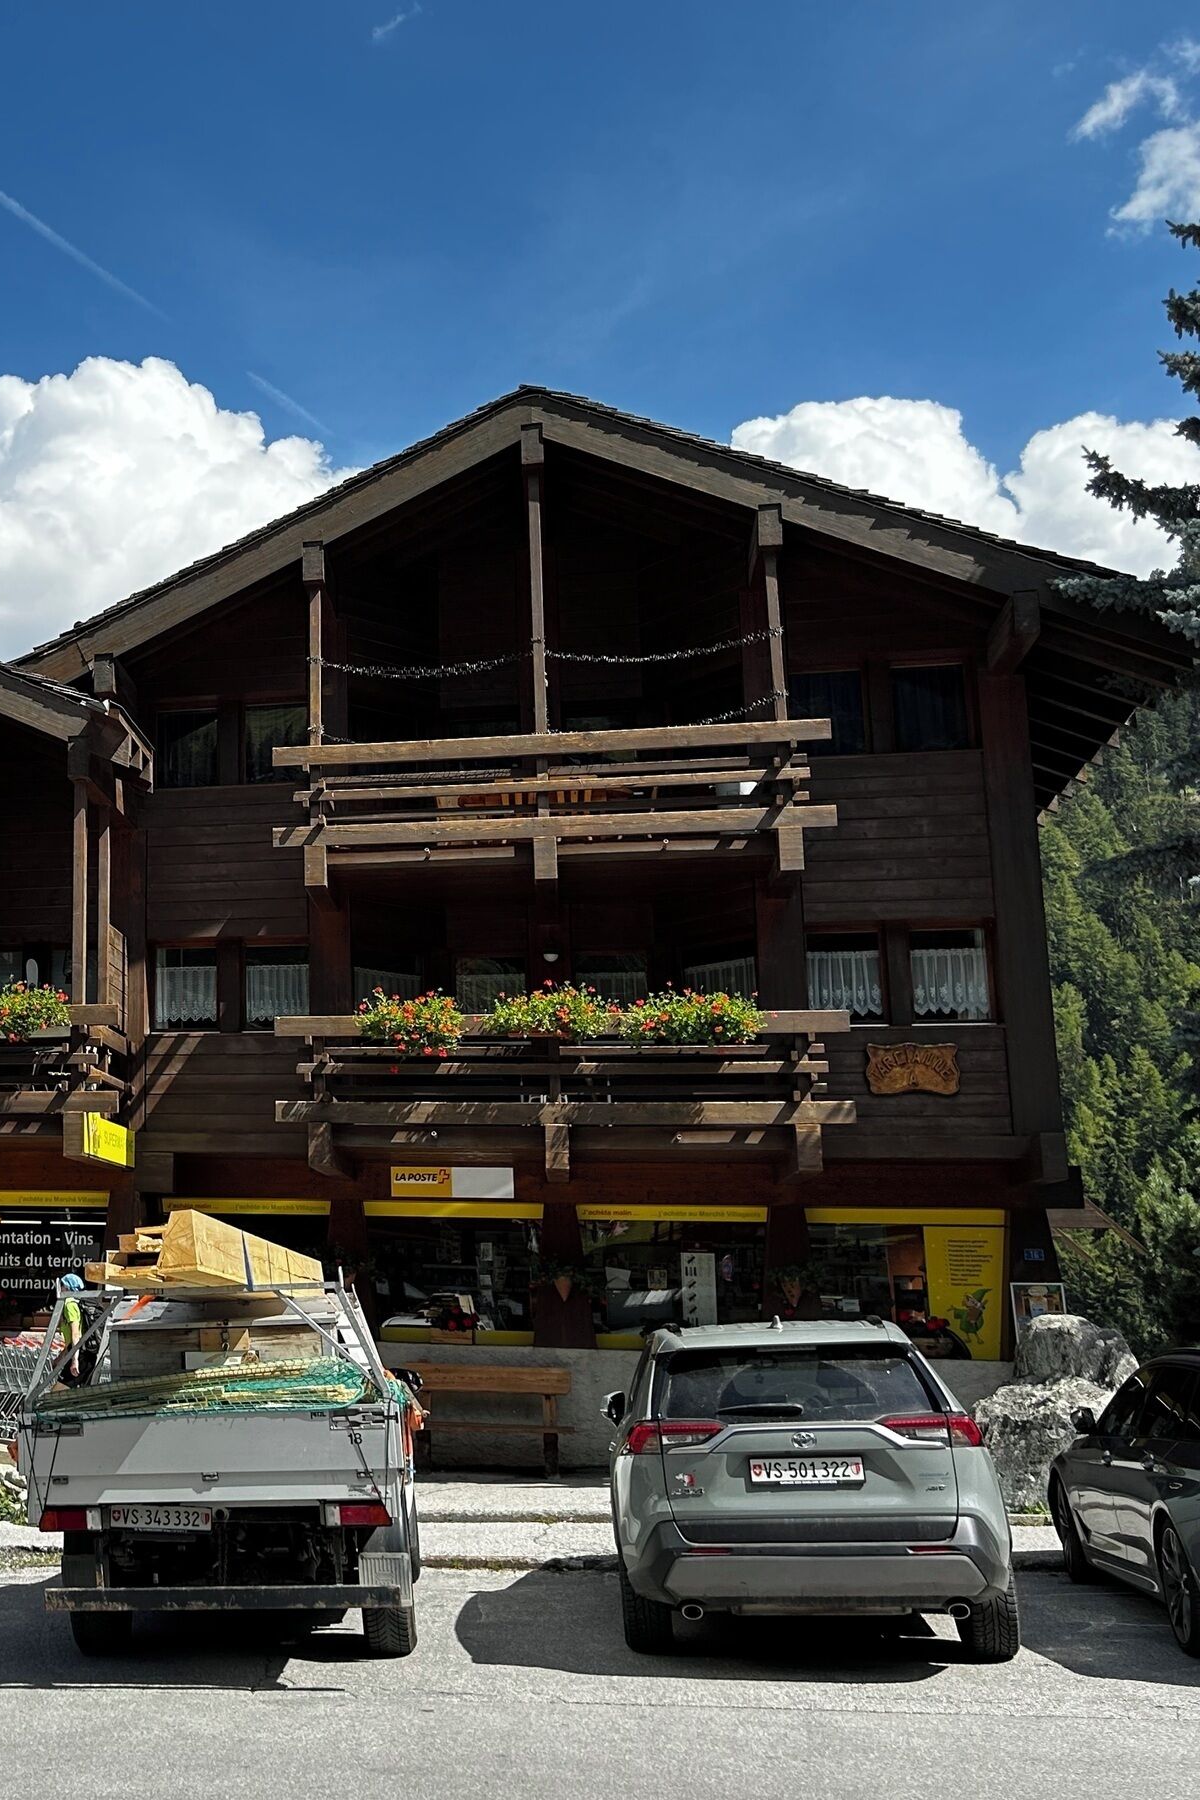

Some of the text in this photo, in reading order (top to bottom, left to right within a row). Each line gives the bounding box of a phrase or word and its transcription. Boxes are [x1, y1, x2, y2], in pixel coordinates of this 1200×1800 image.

[395, 1173, 438, 1182] LA POSTE
[64, 1232, 94, 1246] Vins
[25, 1253, 43, 1267] du
[47, 1254, 93, 1268] terroir
[348, 1433, 363, 1445] 18
